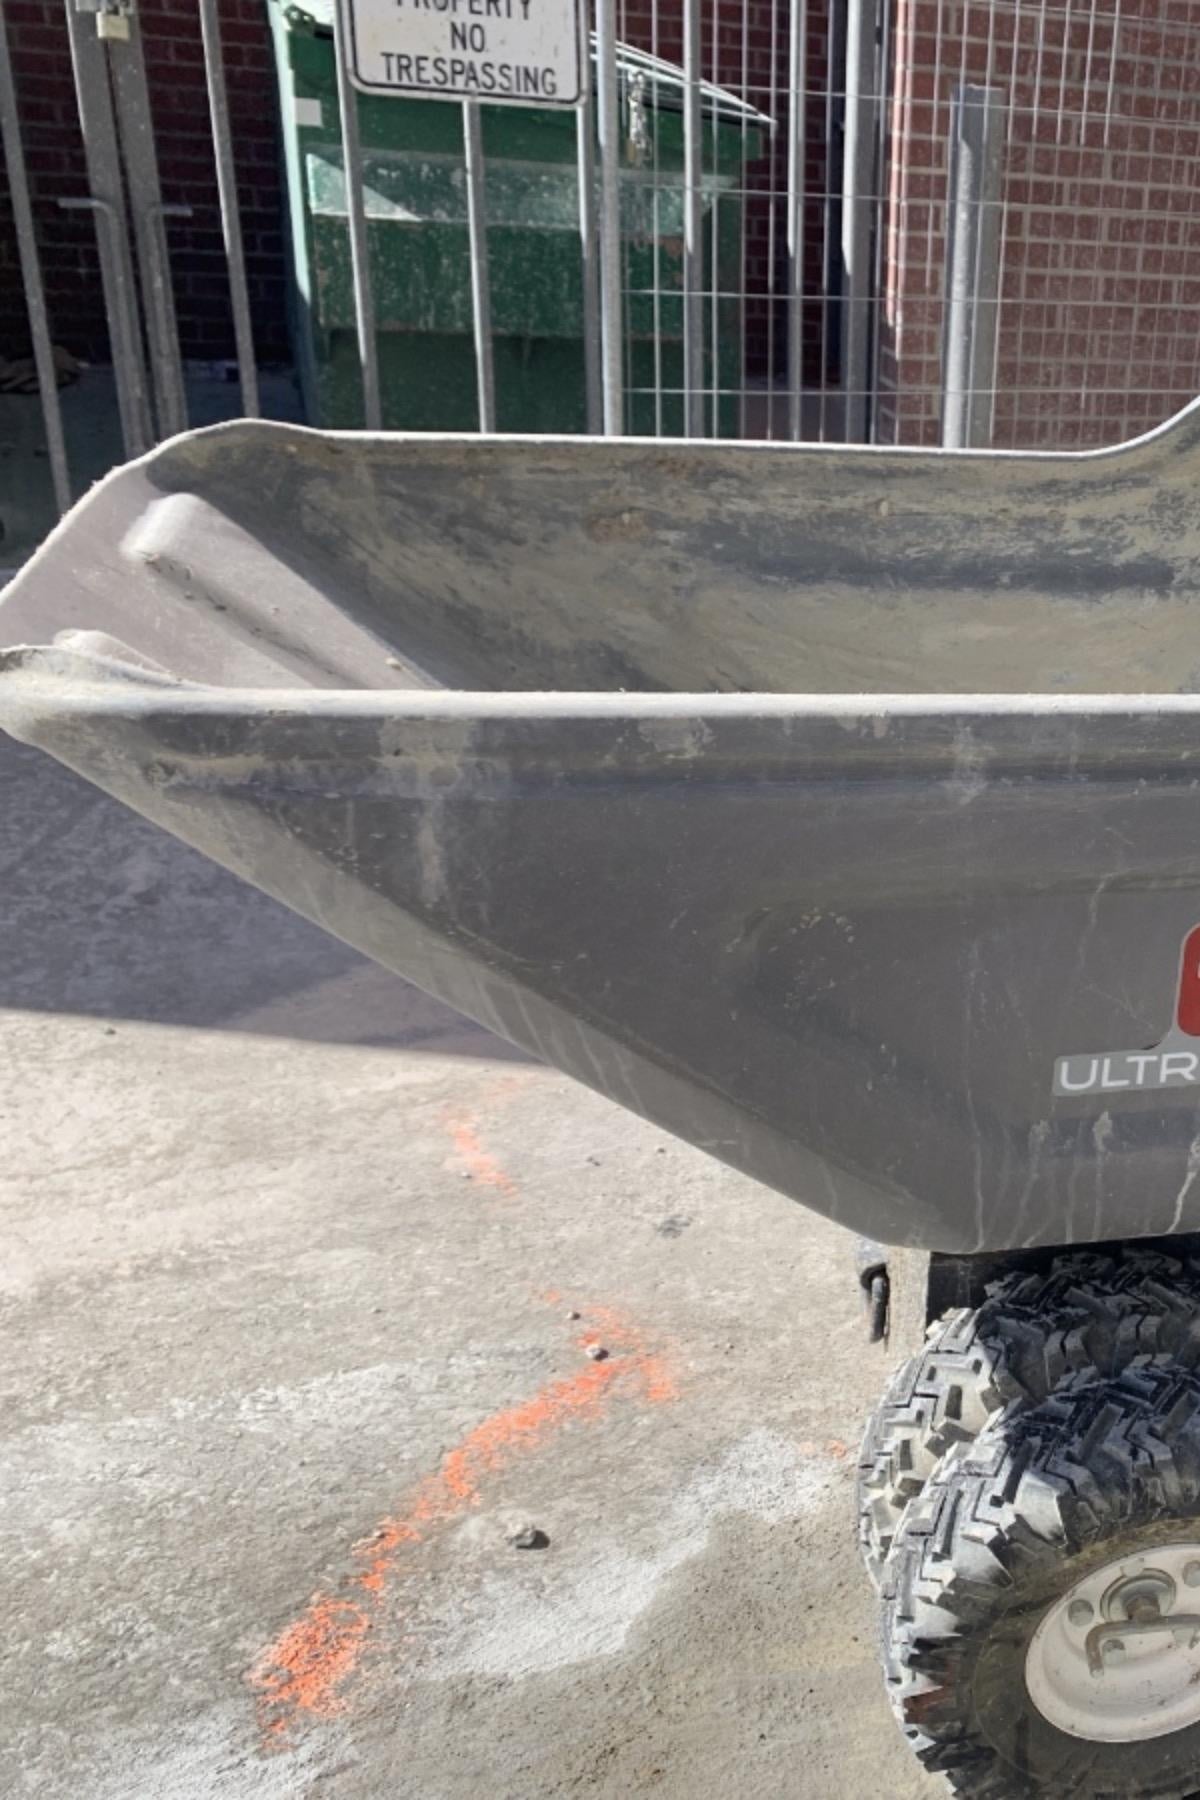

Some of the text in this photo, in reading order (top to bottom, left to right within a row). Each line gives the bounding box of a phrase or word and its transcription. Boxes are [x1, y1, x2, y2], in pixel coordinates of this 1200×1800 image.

[395, 0, 531, 20] ERTY
[450, 21, 486, 52] NO
[381, 52, 557, 96] TRESPASSING
